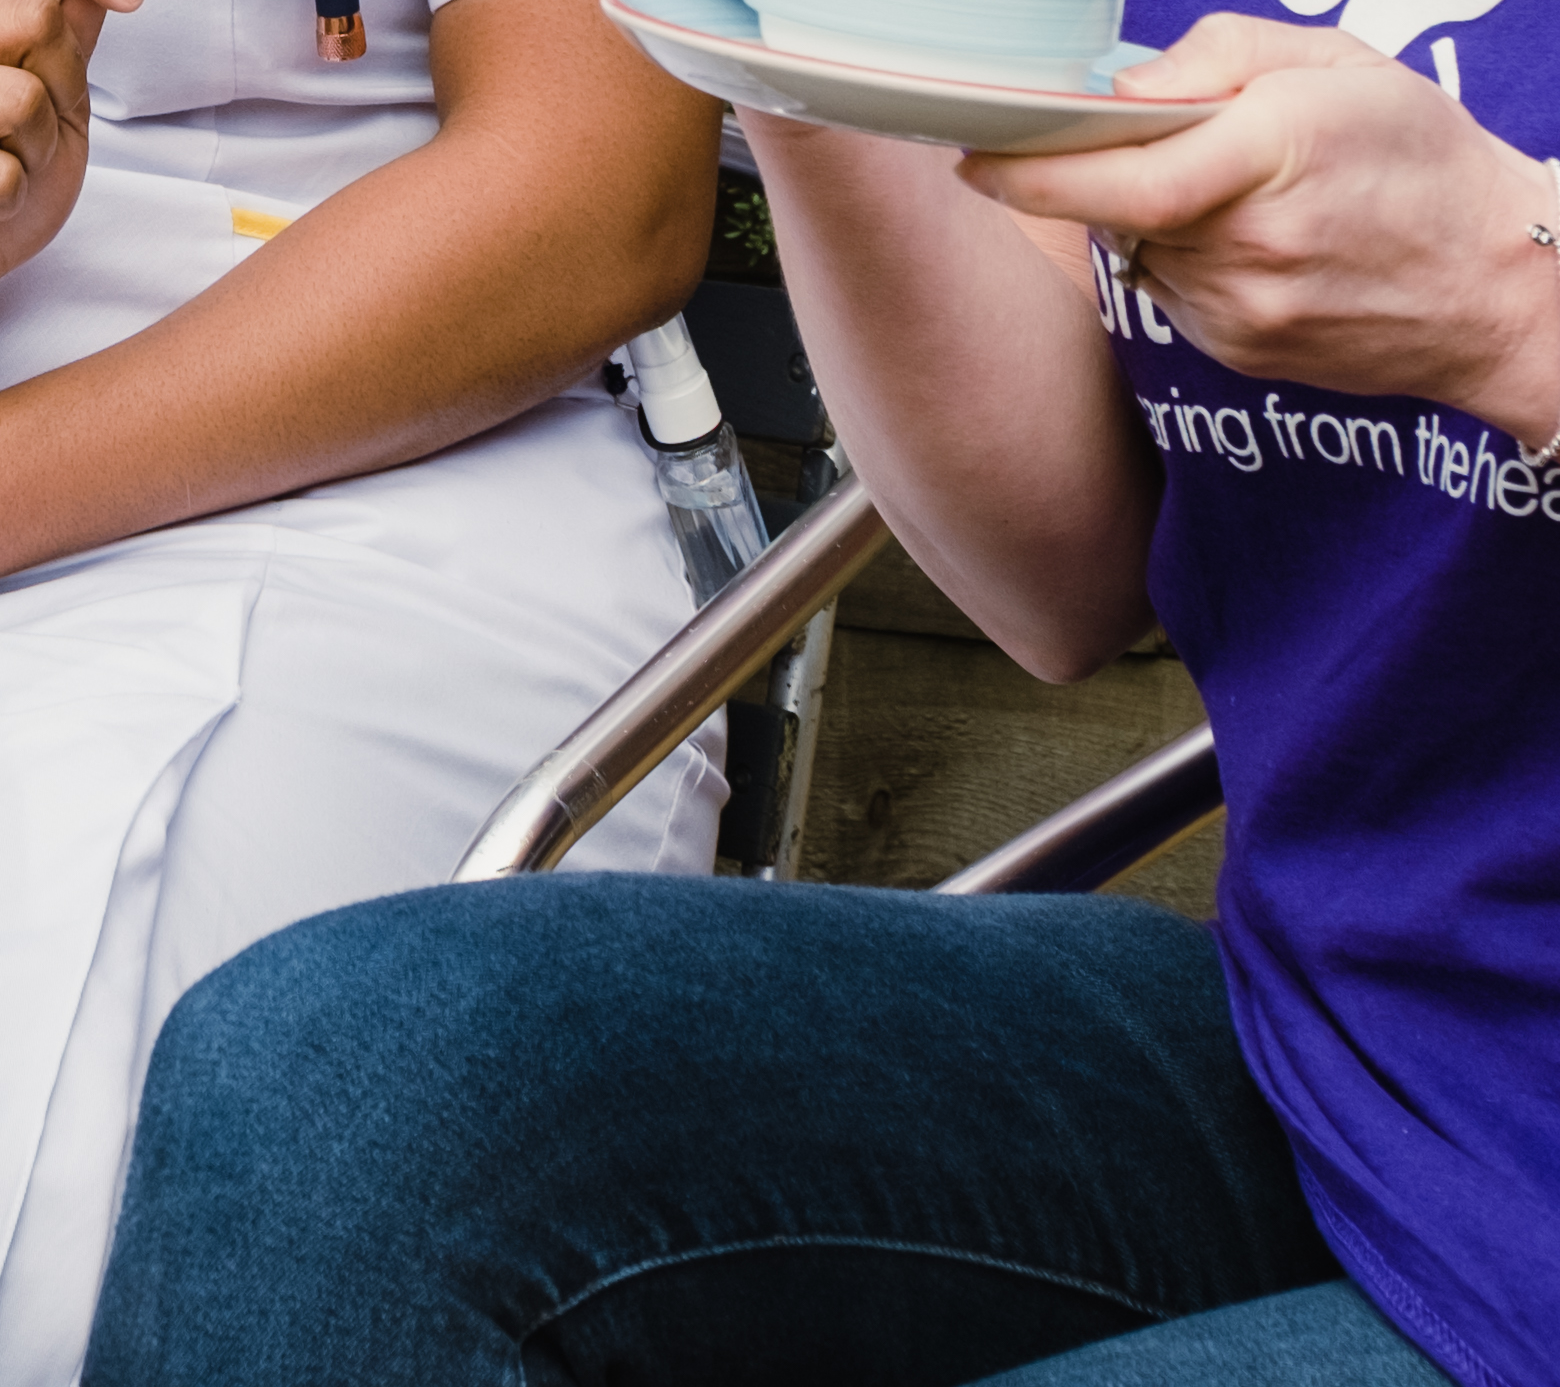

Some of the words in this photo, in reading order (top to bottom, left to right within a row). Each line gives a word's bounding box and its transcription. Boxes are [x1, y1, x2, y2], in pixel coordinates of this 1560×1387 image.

[1136, 385, 1264, 473] aring
[1263, 392, 1405, 477] from
[1414, 413, 1471, 499] the
